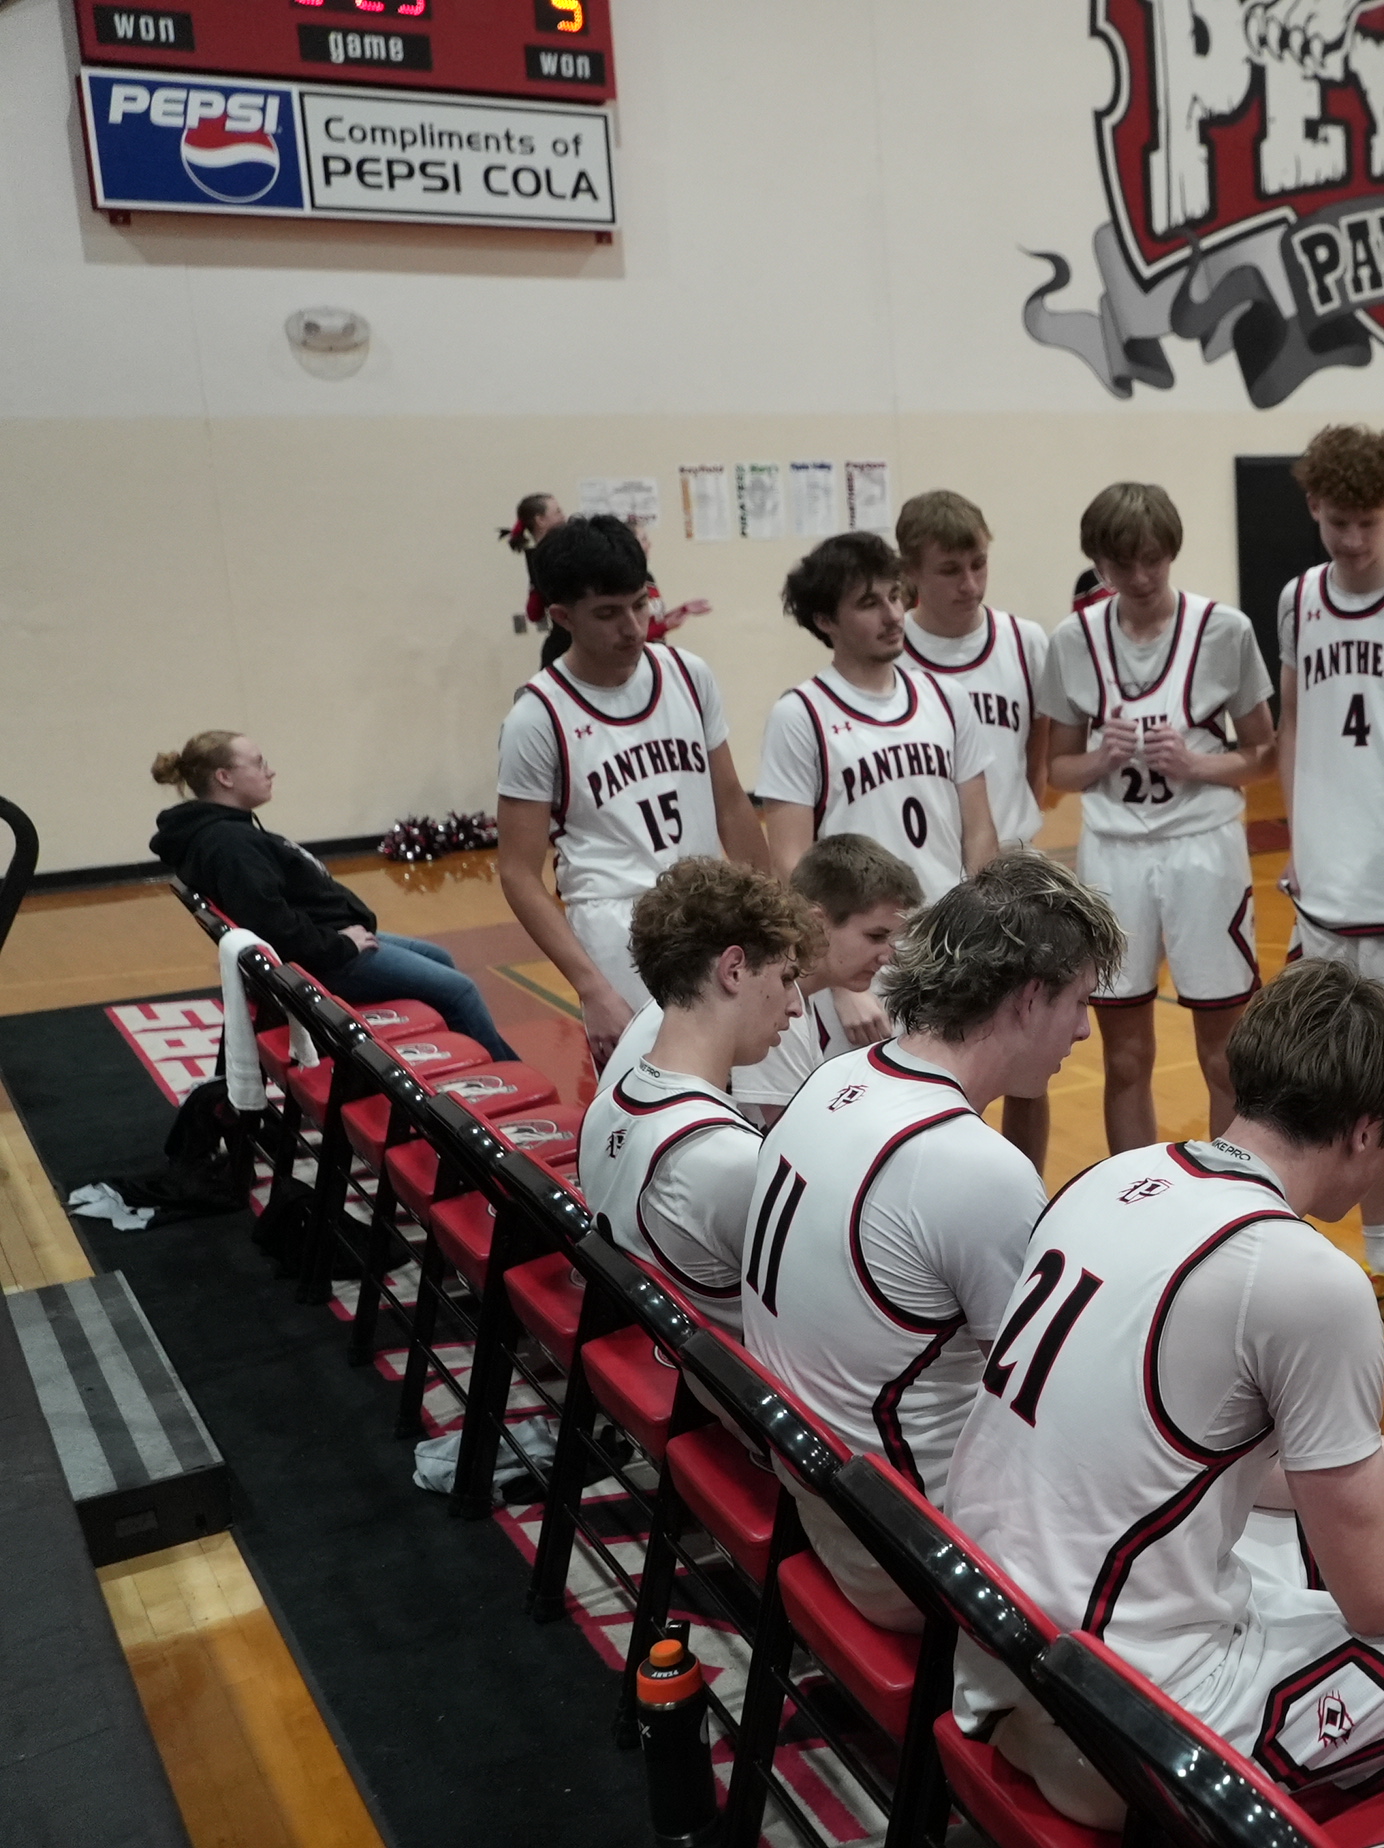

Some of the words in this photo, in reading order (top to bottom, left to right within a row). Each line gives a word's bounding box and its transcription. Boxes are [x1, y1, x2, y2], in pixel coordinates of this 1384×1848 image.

[113, 12, 176, 43] won
[328, 31, 405, 64] game
[539, 51, 592, 79] won
[108, 83, 280, 135] PEPSI
[323, 115, 536, 154] Compliments
[552, 133, 583, 158] of
[322, 155, 462, 194] PEPSI
[483, 165, 600, 202] COLA
[1341, 693, 1371, 747] 4
[586, 738, 706, 810] PANTHERS
[841, 742, 954, 806] PANTHER
[636, 789, 683, 853] 15
[902, 796, 928, 849] 0
[746, 1153, 808, 1318] 11
[982, 1248, 1104, 1428] 21
